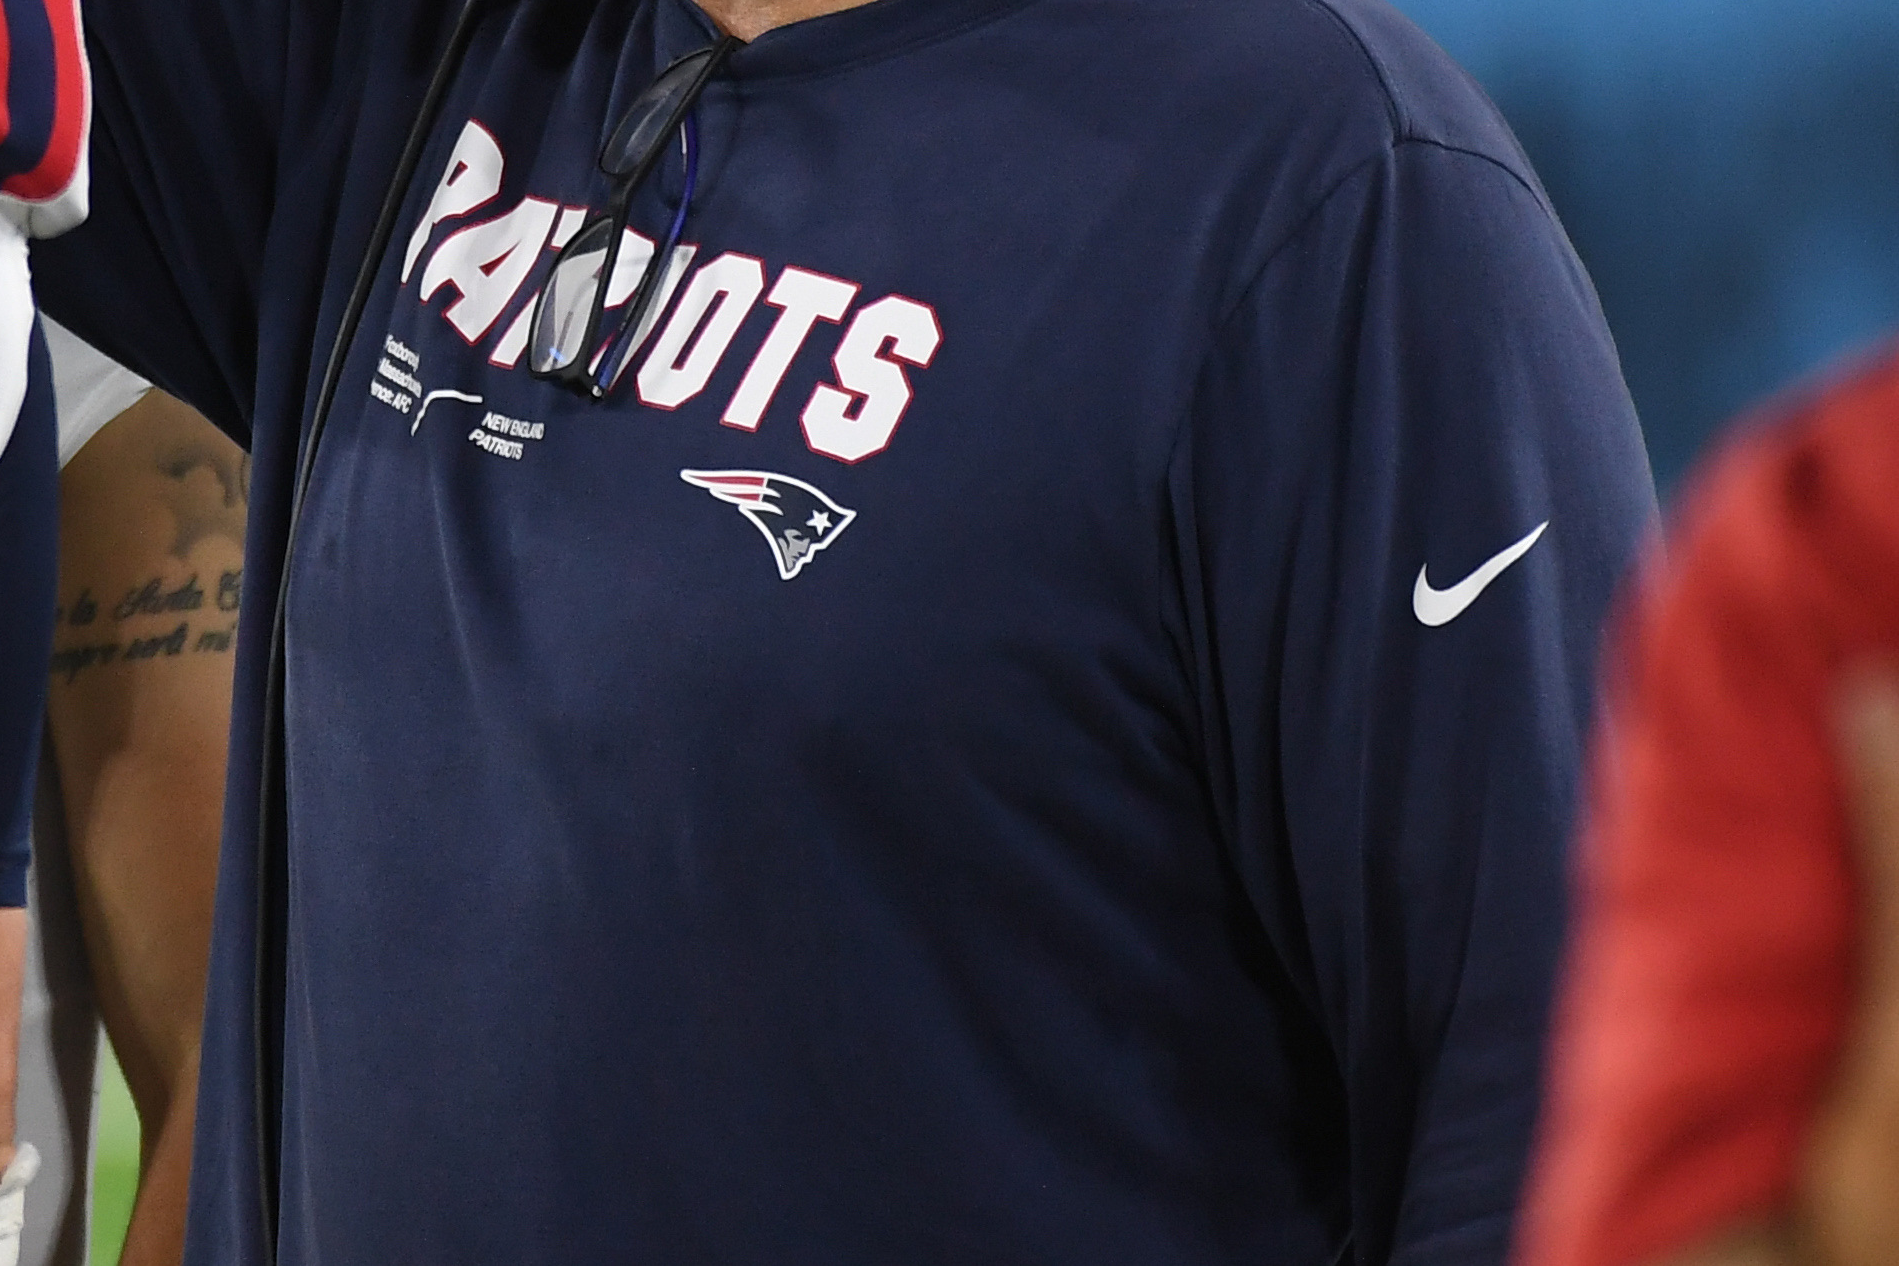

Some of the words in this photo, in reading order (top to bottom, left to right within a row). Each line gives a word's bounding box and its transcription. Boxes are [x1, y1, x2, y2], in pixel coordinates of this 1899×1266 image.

[481, 411, 510, 434] NEW
[510, 419, 545, 440] ENGLAND
[468, 429, 524, 460] PATRIOTS
